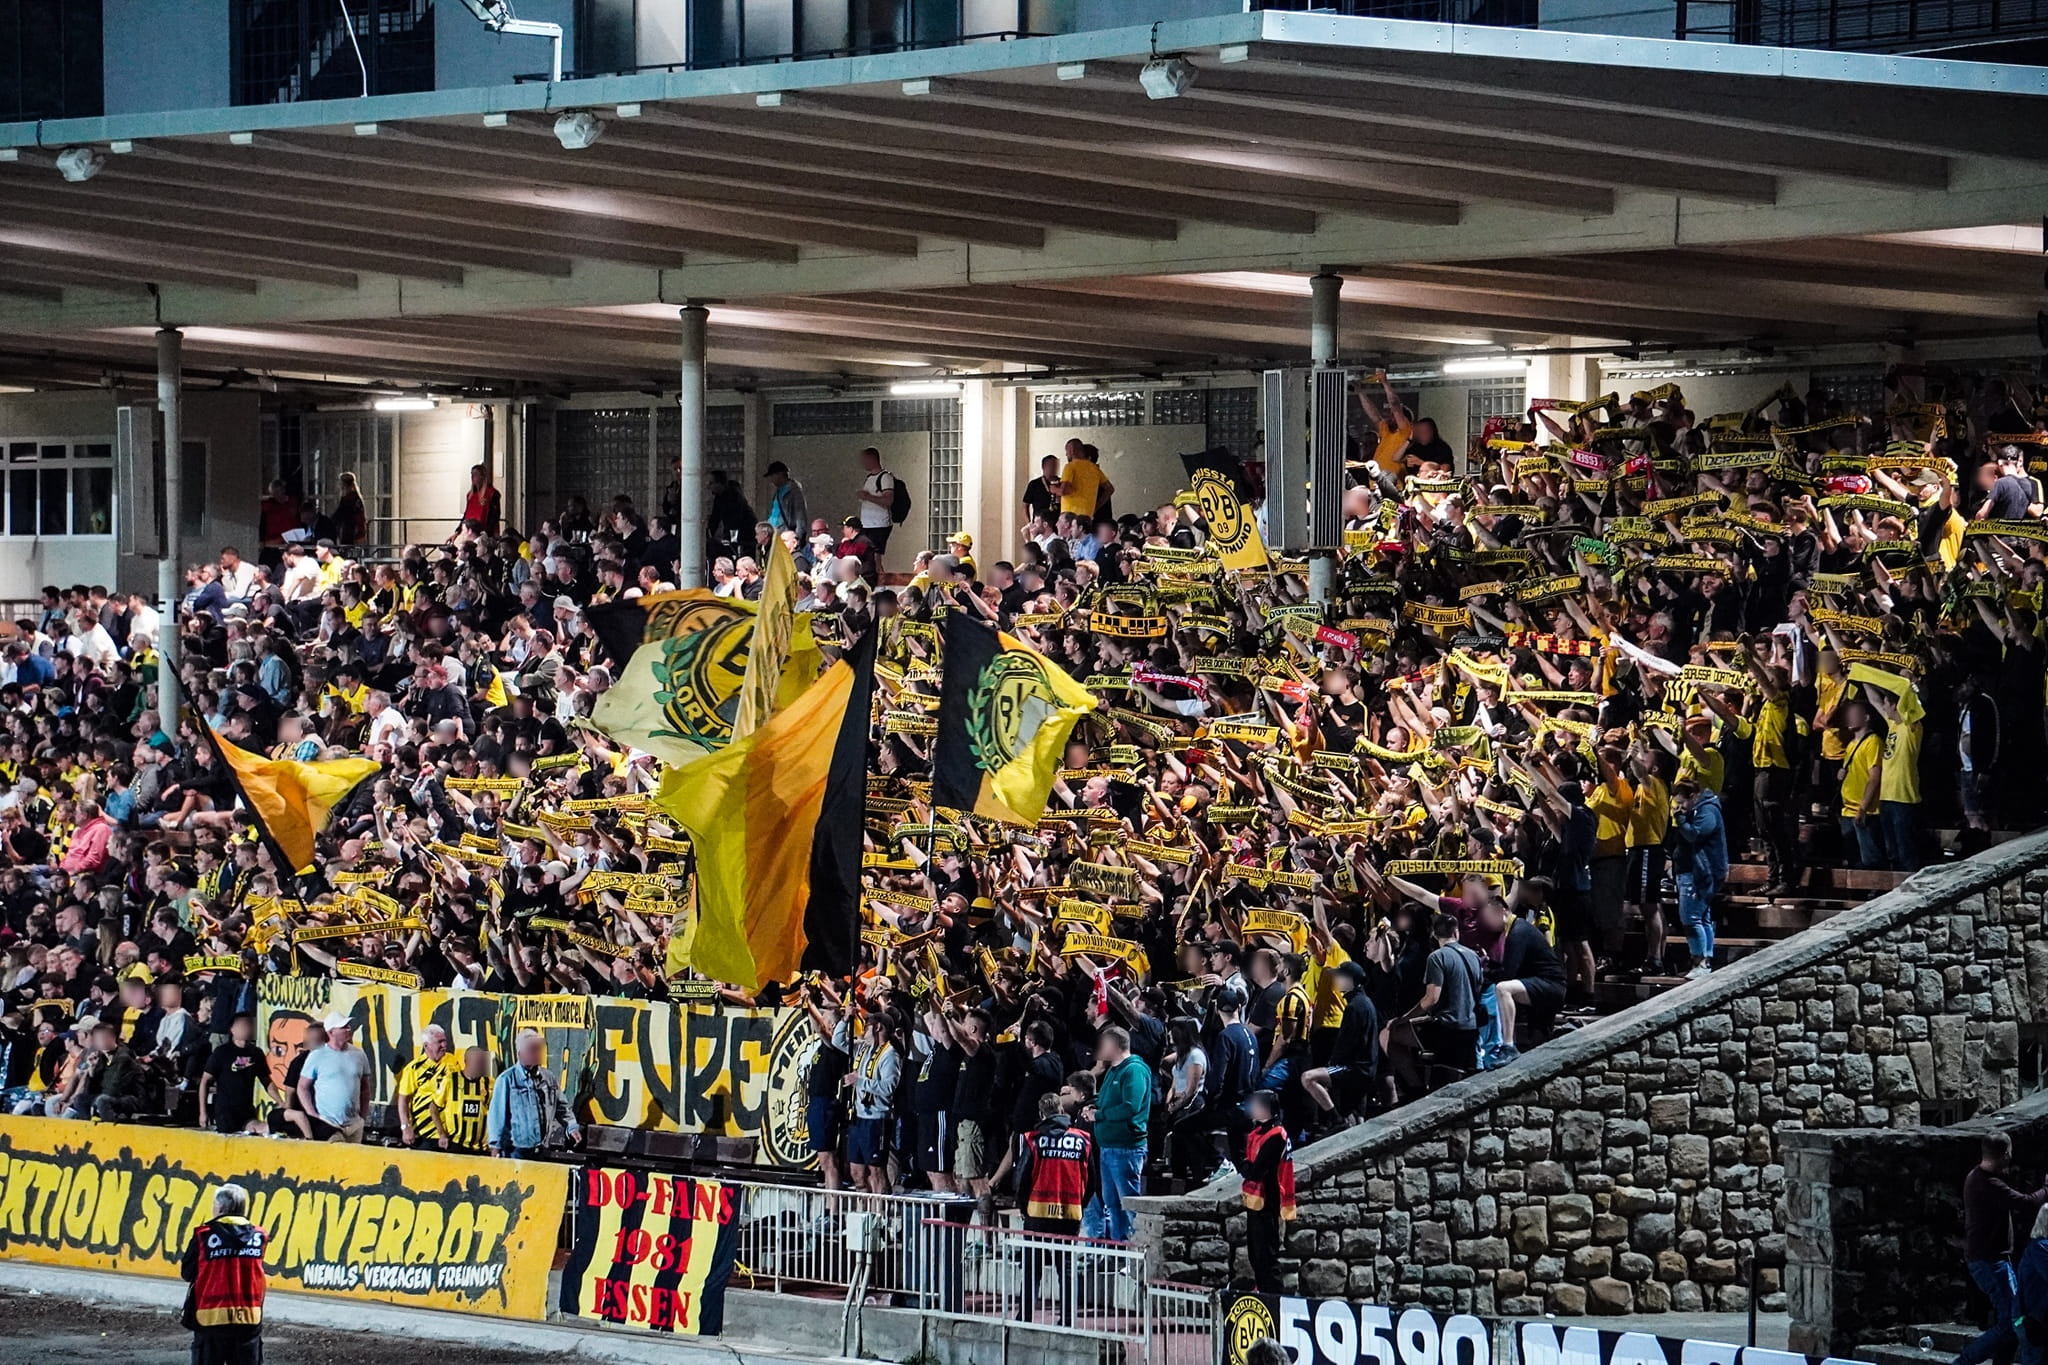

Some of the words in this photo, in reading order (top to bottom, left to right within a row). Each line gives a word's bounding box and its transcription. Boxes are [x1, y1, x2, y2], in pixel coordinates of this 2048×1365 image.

[1201, 486, 1236, 523] BVB
[1217, 522, 1230, 534] 09
[1214, 724, 1242, 736] KLEVE
[1248, 725, 1268, 738] 1909
[1386, 860, 1438, 875] RUSSIA
[464, 1102, 480, 1114] 1&1
[587, 1169, 734, 1225] DO-FANS
[133, 1174, 510, 1270] STAIONVERBOT
[611, 1228, 693, 1274] 1981
[303, 1263, 358, 1288] NIEMALS
[363, 1264, 433, 1290] VERZAGEN
[437, 1263, 504, 1289] FREUNDE!
[591, 1276, 692, 1329] ESSEN
[1279, 1296, 1490, 1365] 59590
